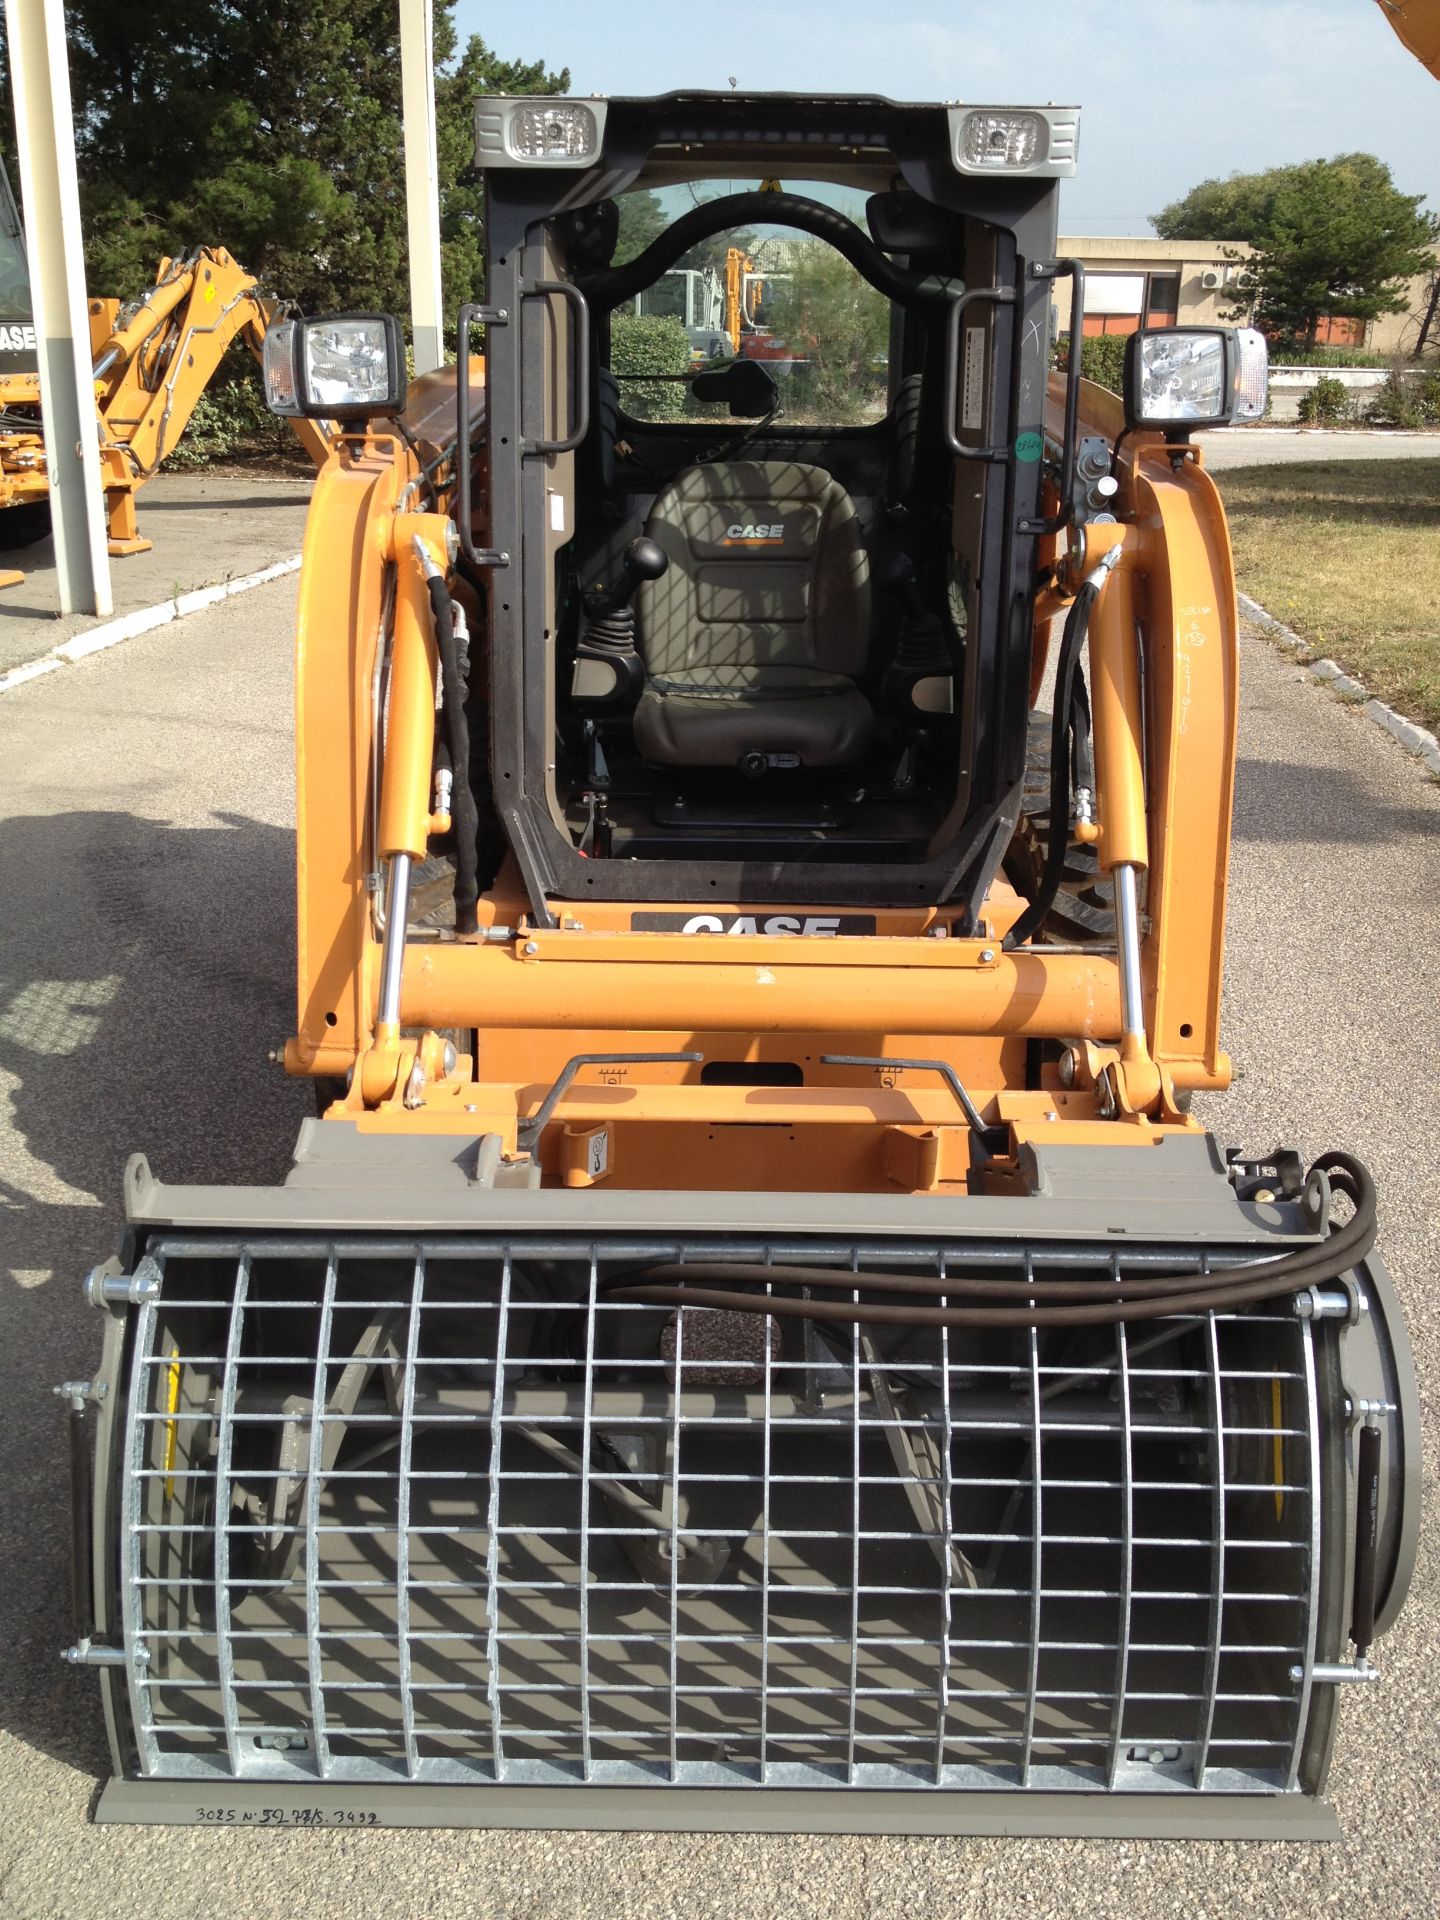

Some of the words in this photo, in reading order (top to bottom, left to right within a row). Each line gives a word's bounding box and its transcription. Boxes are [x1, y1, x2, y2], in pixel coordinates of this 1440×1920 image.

[727, 524, 784, 539] CASE
[682, 915, 841, 936] CASE
[195, 1807, 237, 1823] 3025
